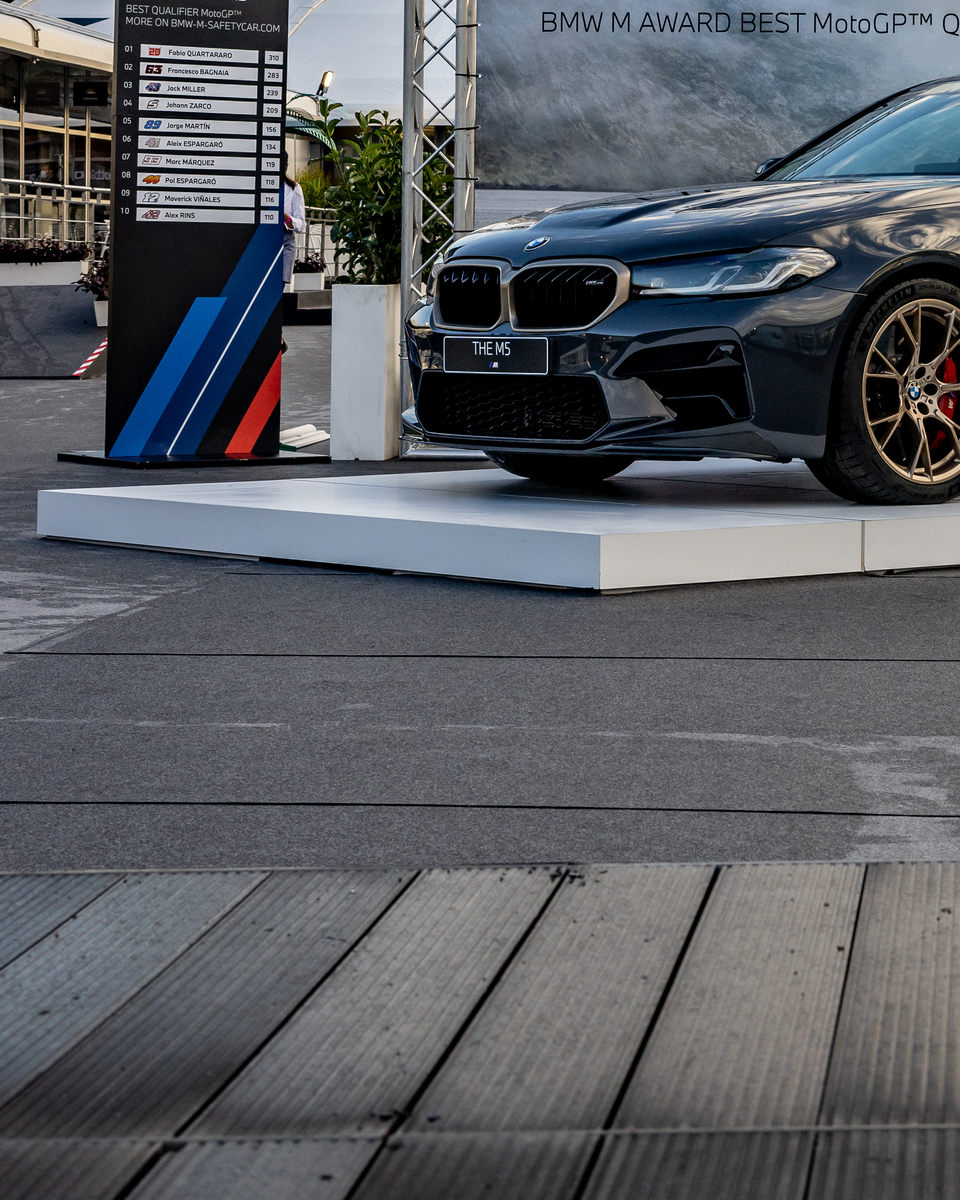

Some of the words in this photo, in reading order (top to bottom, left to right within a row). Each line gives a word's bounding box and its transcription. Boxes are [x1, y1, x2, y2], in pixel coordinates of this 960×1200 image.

[125, 4, 150, 14] BEST
[151, 5, 199, 17] QUALIFIER
[200, 8, 242, 19] MotoGP™
[125, 16, 153, 26] MORE
[154, 17, 169, 27] ON
[170, 20, 281, 33] BMW-M-SAFETYCAR.COM
[541, 11, 603, 33] BMW
[611, 11, 631, 33] M
[638, 11, 731, 33] AWARD
[740, 11, 806, 34] BEST
[813, 12, 933, 34] MotoGP™
[148, 47, 161, 57] 20
[187, 50, 233, 59] QUARTARARO
[124, 63, 133, 71] 02
[144, 64, 163, 75] 63
[167, 67, 199, 75] Francesco
[199, 69, 230, 77] BAGNAIA
[123, 81, 133, 89] 03
[123, 99, 133, 107] 04
[189, 102, 212, 110] ZARCO
[122, 117, 132, 125] 05
[143, 119, 163, 130] 89
[166, 122, 184, 130] Jorge
[184, 121, 211, 130] MARTÍN
[122, 135, 132, 143] 06
[183, 140, 224, 148] ESPARGARÓ
[121, 153, 131, 161] 07
[182, 157, 215, 167] MÁRQUEZ
[121, 171, 131, 179] 08
[176, 177, 217, 185] ESPARGARÓ
[265, 178, 275, 186] 118
[120, 189, 131, 197] 09
[193, 194, 221, 203] VIÑALES
[120, 207, 130, 215] 10
[472, 341, 494, 356] THE
[495, 341, 511, 356] M5
